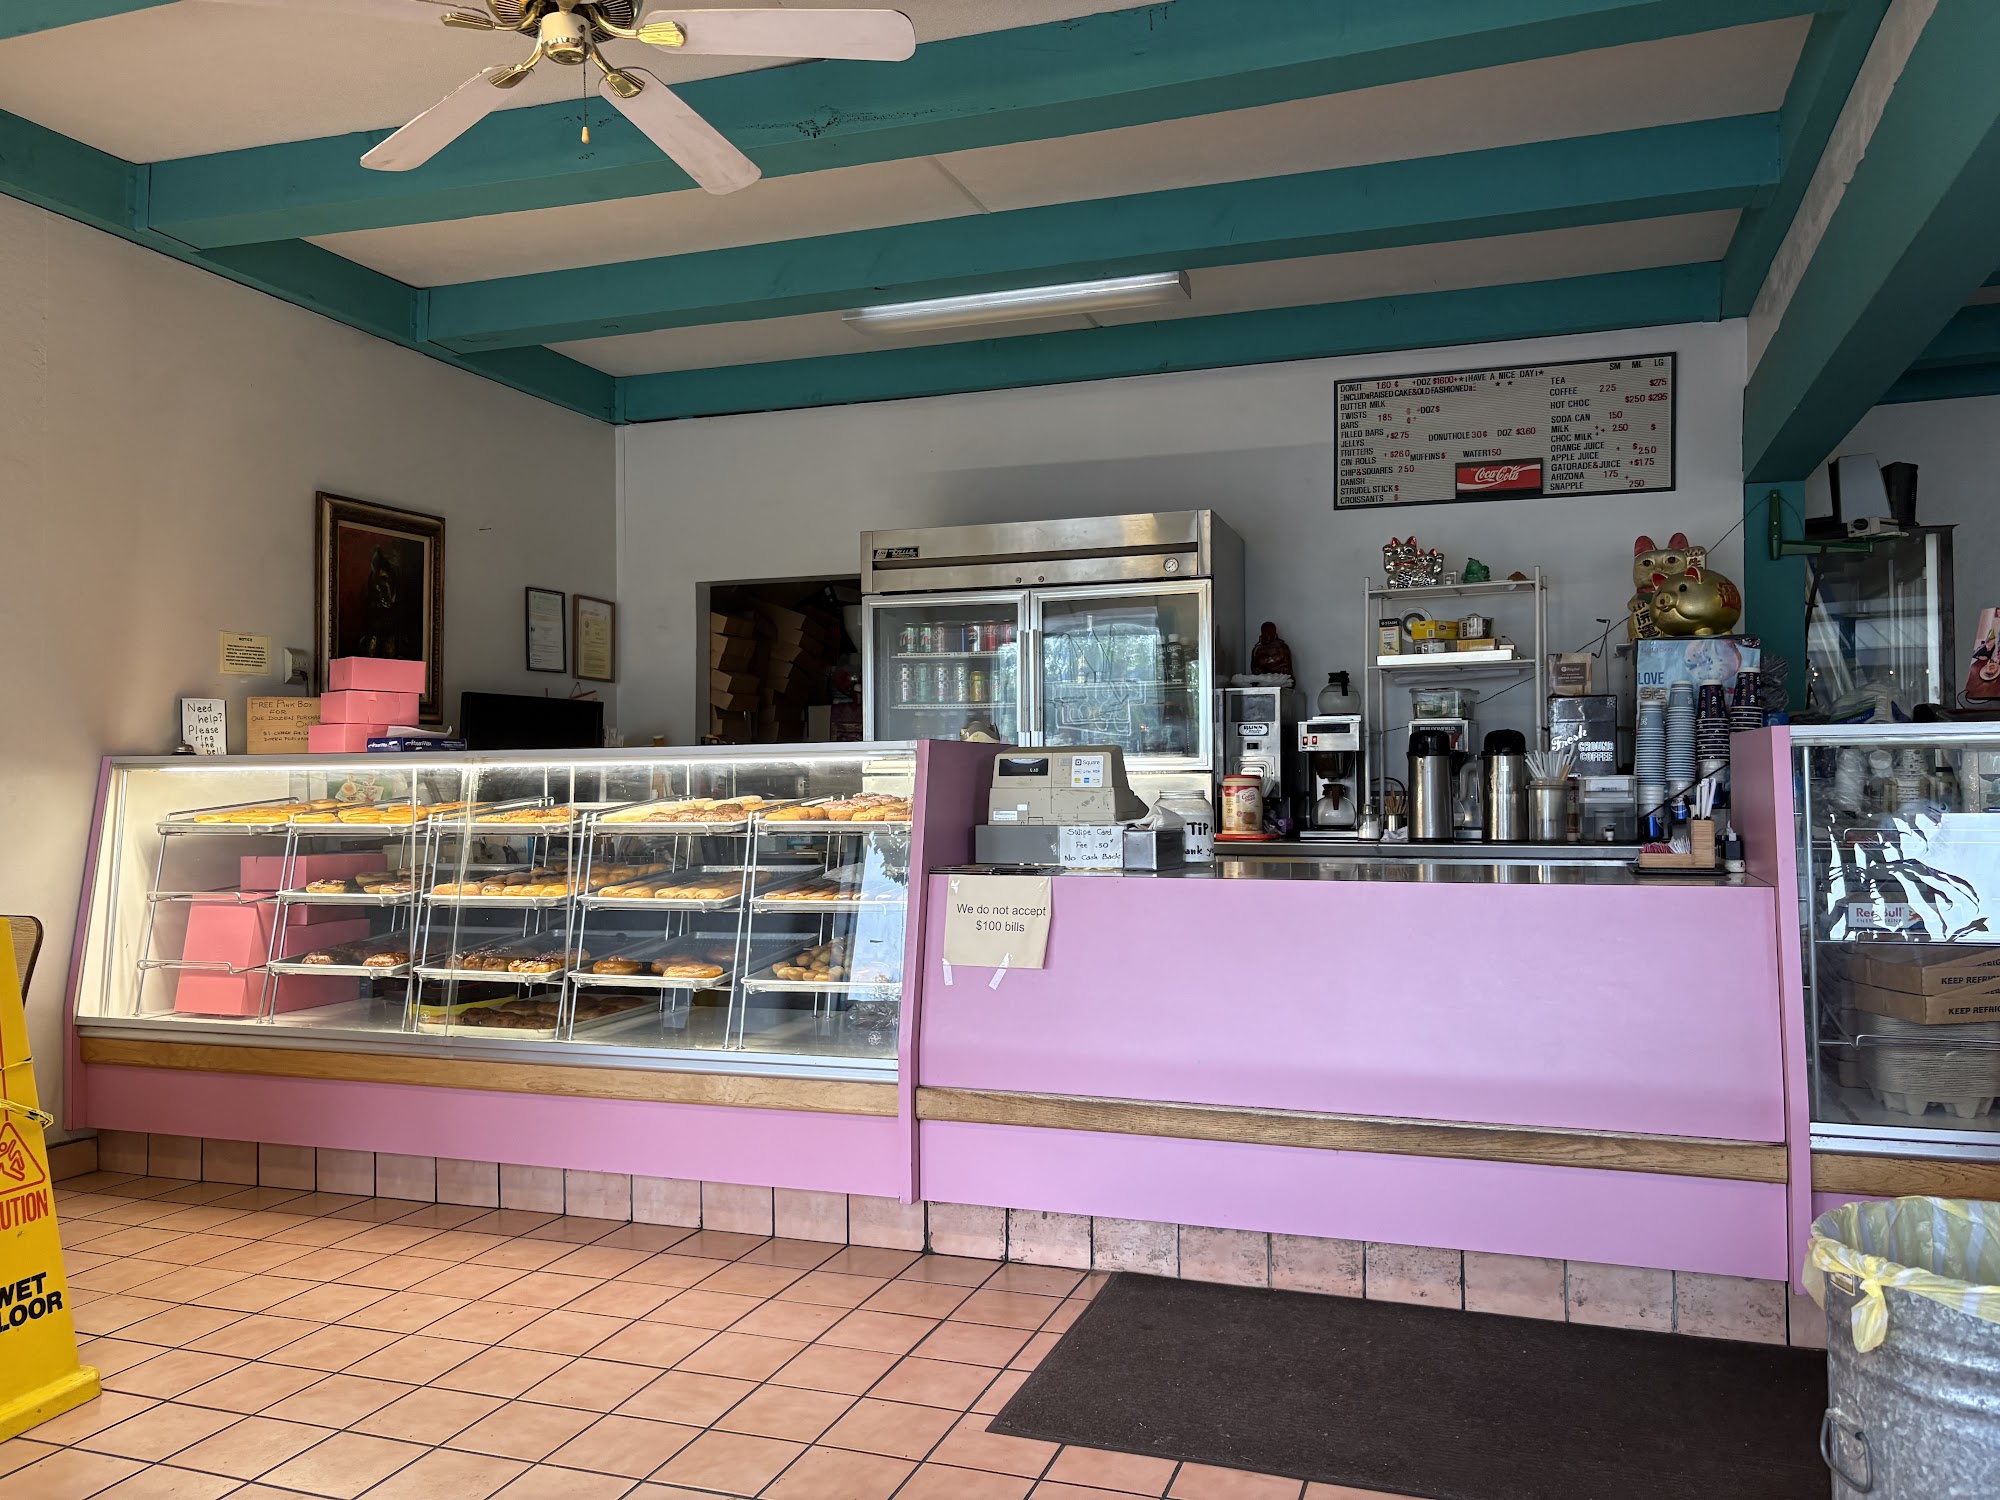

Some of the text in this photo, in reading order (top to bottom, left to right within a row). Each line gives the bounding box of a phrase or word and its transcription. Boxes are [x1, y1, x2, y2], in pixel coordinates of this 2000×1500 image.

[1610, 362, 1621, 370] SM
[1654, 358, 1664, 367] LG
[1340, 383, 1362, 392] DONUT
[1490, 372, 1495, 381] A
[1499, 370, 1516, 380] NICE
[1551, 376, 1566, 385] TEA
[1549, 386, 1578, 397] COFFEE
[1340, 400, 1386, 411] BUTTER MILK
[1550, 400, 1566, 410] HOT
[1567, 398, 1590, 408] CHOC
[1340, 410, 1368, 421] TWISTS
[1551, 414, 1572, 424] SODA
[1574, 413, 1591, 422] CAN
[1340, 420, 1359, 430] BARS
[1551, 424, 1570, 434] MILK
[1340, 430, 1363, 439] FILLED
[1365, 428, 1384, 438] BARS
[1497, 429, 1512, 438] DOZ
[1550, 432, 1593, 443] CHOC MILK
[1340, 439, 1365, 448] JELLYS
[1550, 442, 1581, 453] ORANGE
[1583, 441, 1605, 450] JUICE
[1340, 447, 1374, 457] FRITTERS
[1551, 451, 1600, 462] APPLE JUICE
[1340, 456, 1377, 467] CIN ROLLS
[1551, 471, 1585, 481] ARIZONA
[1340, 477, 1366, 487] DANISH
[1550, 481, 1584, 491] SNAPPLE
[1340, 486, 1372, 496] STRUDEL
[1372, 484, 1394, 494] STICK
[1340, 494, 1385, 505] CROISSANTS
[1637, 672, 1665, 685] LOVE
[187, 702, 212, 713] Need
[251, 698, 274, 709] FREE
[197, 712, 223, 725] help?
[188, 724, 219, 736] Please
[195, 734, 215, 744] ring
[1551, 725, 1588, 752] Fresh
[200, 741, 215, 749] the
[1578, 741, 1614, 752] GROUND
[1580, 752, 1613, 762] COFFEE
[1066, 828, 1113, 838] Swipe Card
[1075, 841, 1088, 849] Fee
[1184, 844, 1203, 855] ank
[1101, 852, 1121, 860] Back
[956, 903, 1047, 918] We do not accept
[975, 919, 1025, 932] $100 bills
[1941, 976, 1964, 985] KEEP
[1948, 1007, 1971, 1015] KEEP
